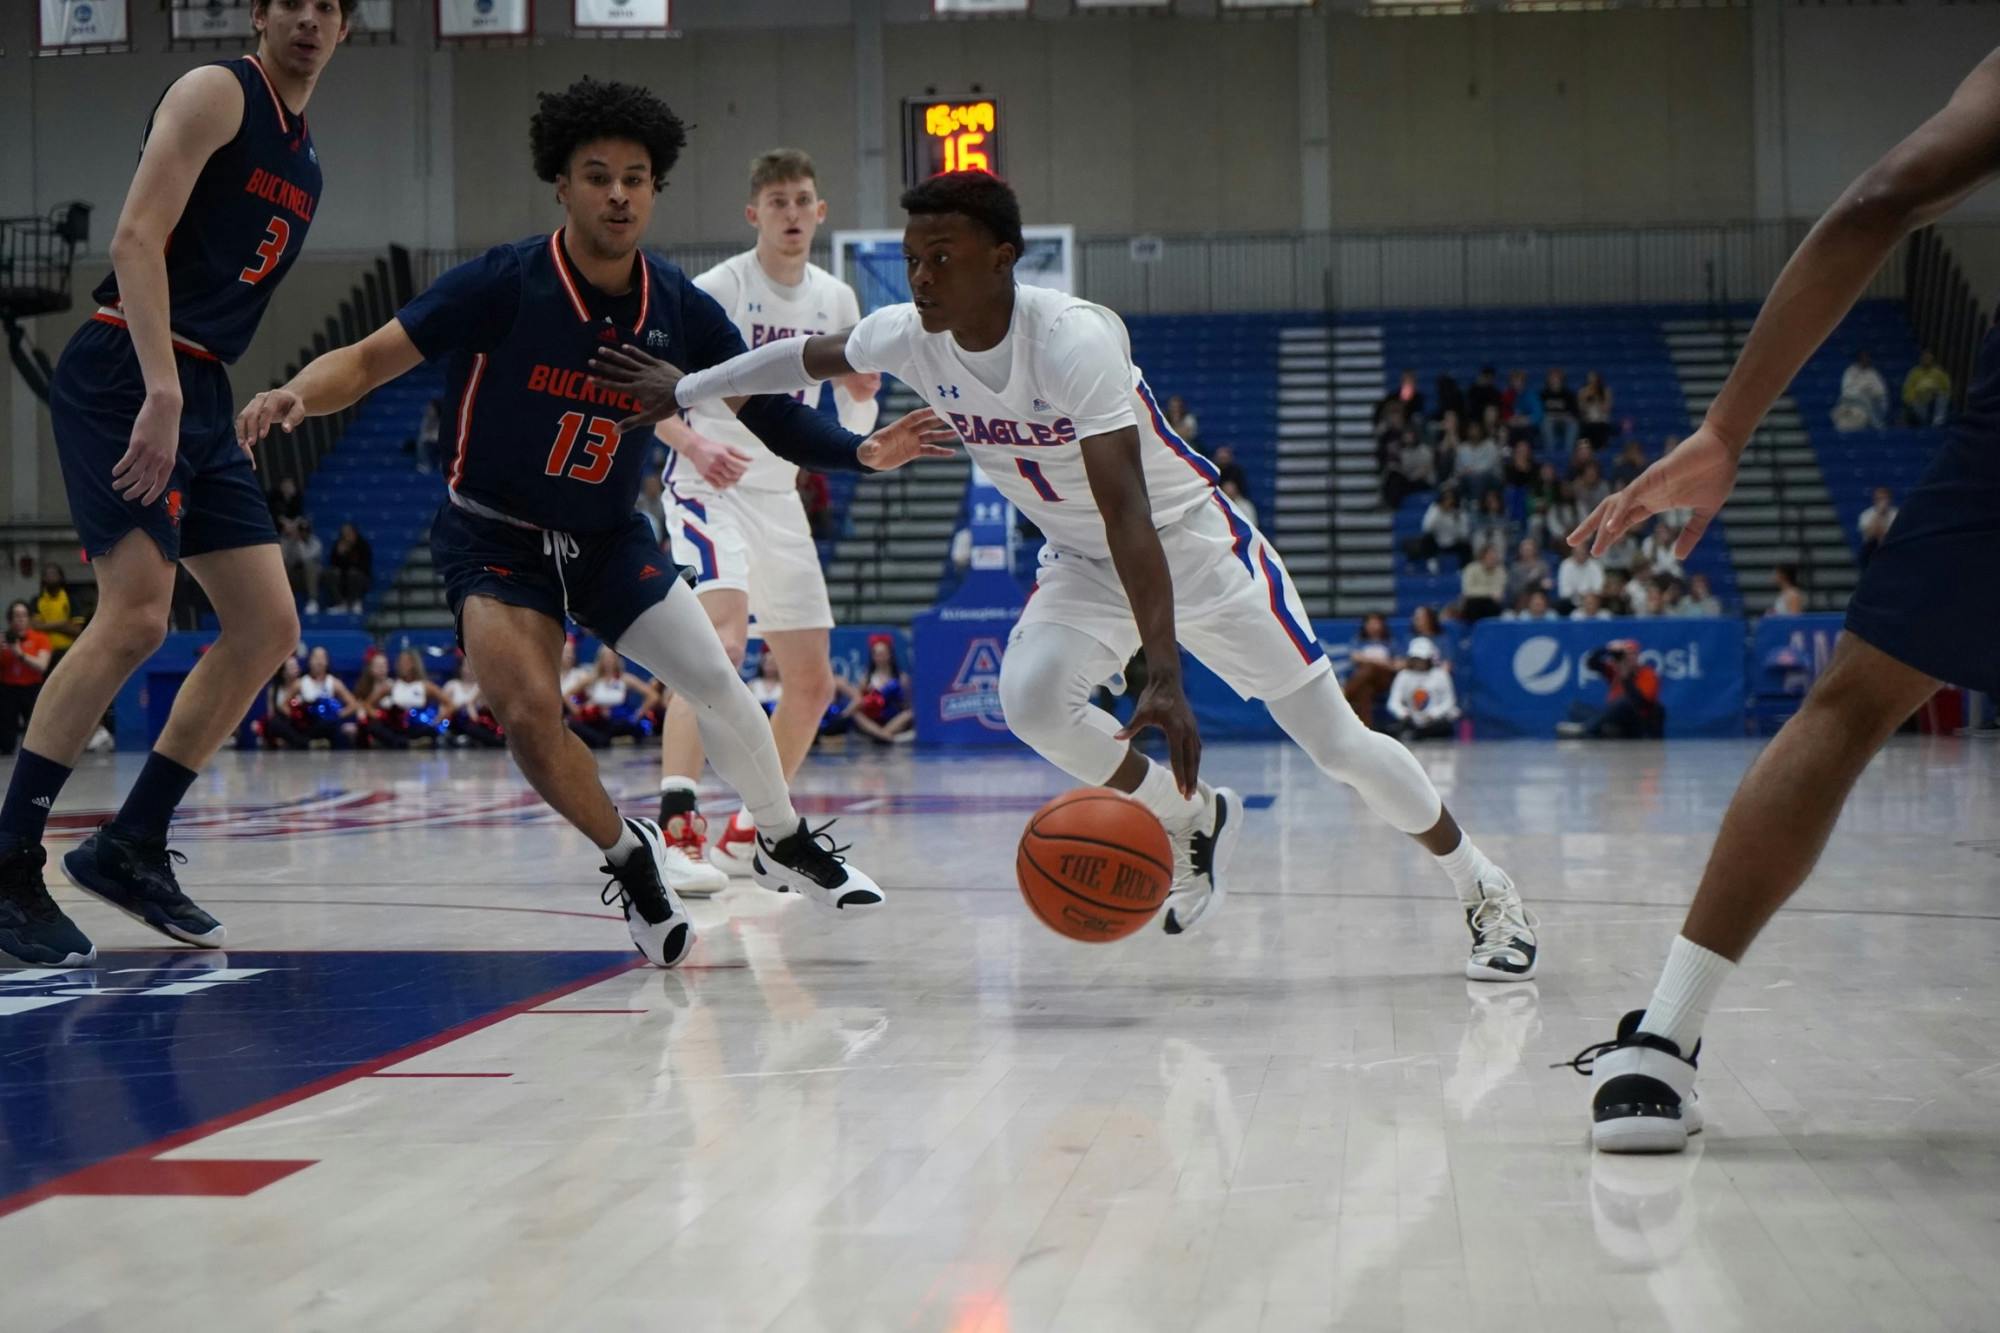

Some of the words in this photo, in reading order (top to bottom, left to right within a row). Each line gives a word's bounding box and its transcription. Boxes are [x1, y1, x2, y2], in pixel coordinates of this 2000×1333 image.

[926, 102, 995, 137] 15:49
[944, 132, 988, 173] 16
[245, 167, 314, 222] BUCKNELL
[239, 216, 290, 285] 3
[544, 411, 621, 485] 13
[946, 411, 1078, 447] EAGLES
[1014, 457, 1066, 503] 1
[1060, 854, 1107, 890] THE
